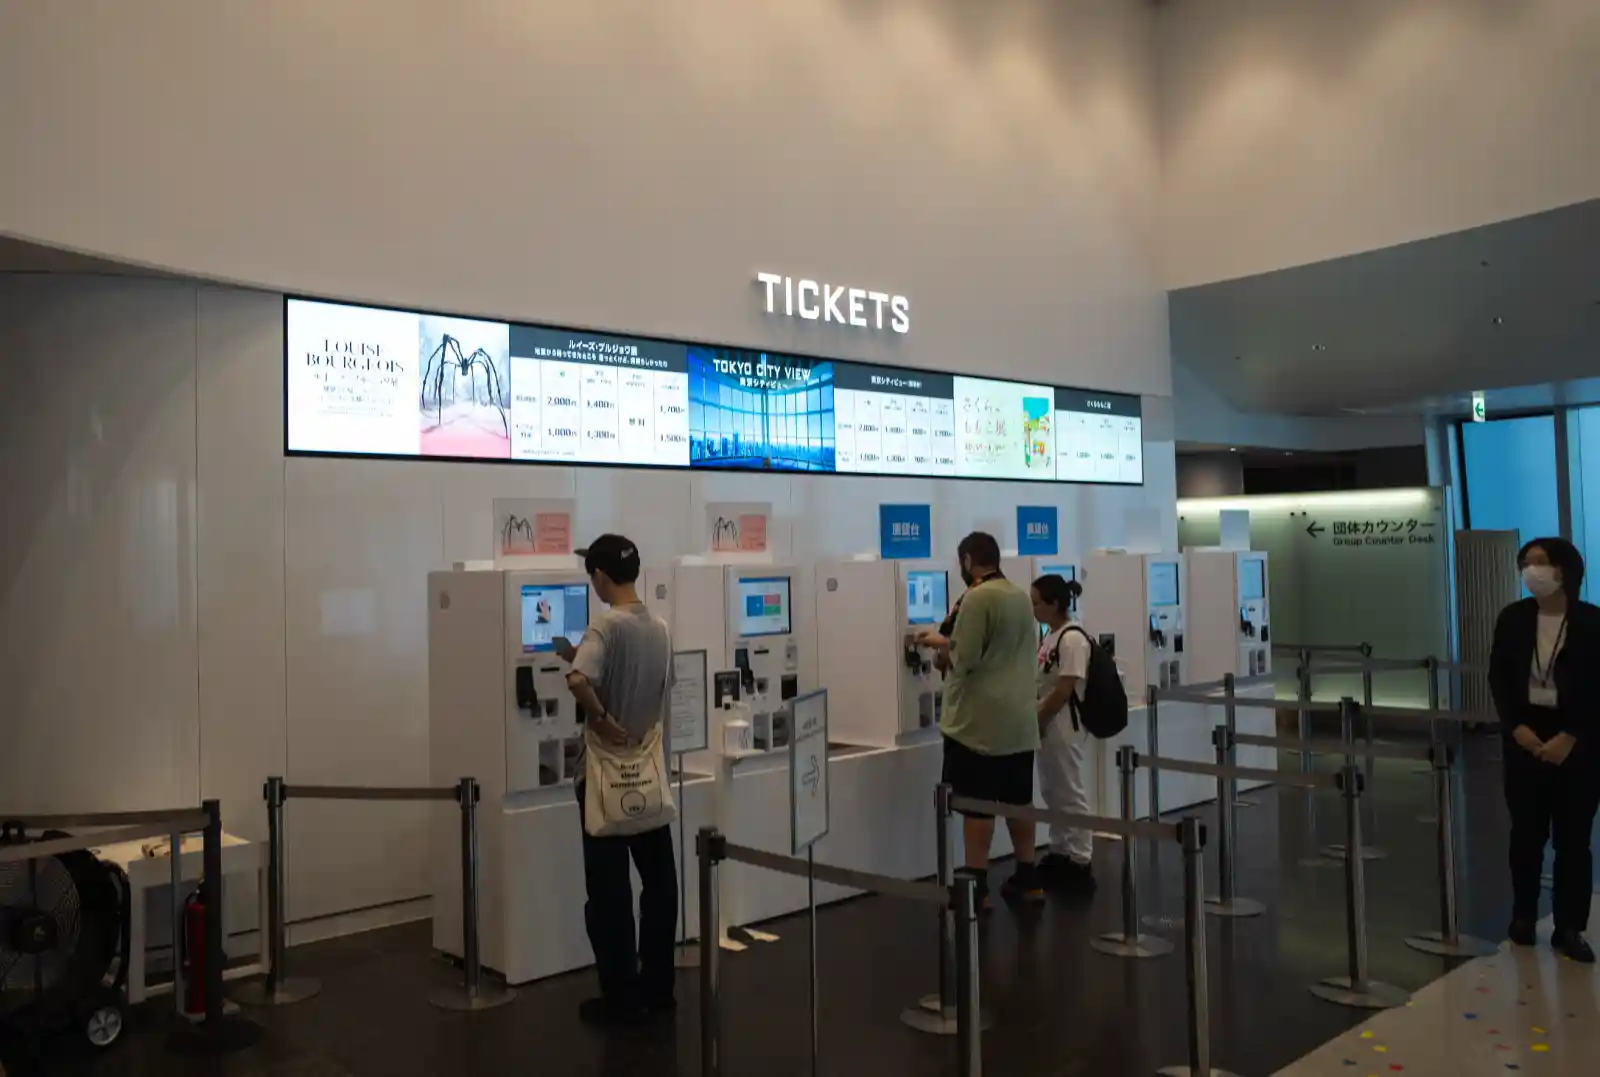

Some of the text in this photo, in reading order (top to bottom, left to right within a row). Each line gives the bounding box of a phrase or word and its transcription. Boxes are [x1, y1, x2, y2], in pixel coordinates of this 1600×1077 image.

[757, 271, 910, 334] TICKETS
[324, 339, 385, 357] LOUISE
[306, 351, 405, 373] BOURGEOIS
[713, 358, 812, 381] TOKYO CITY VIEW
[1332, 519, 1436, 535] 団体カウンター
[1333, 534, 1435, 547] Group Counter Desk
